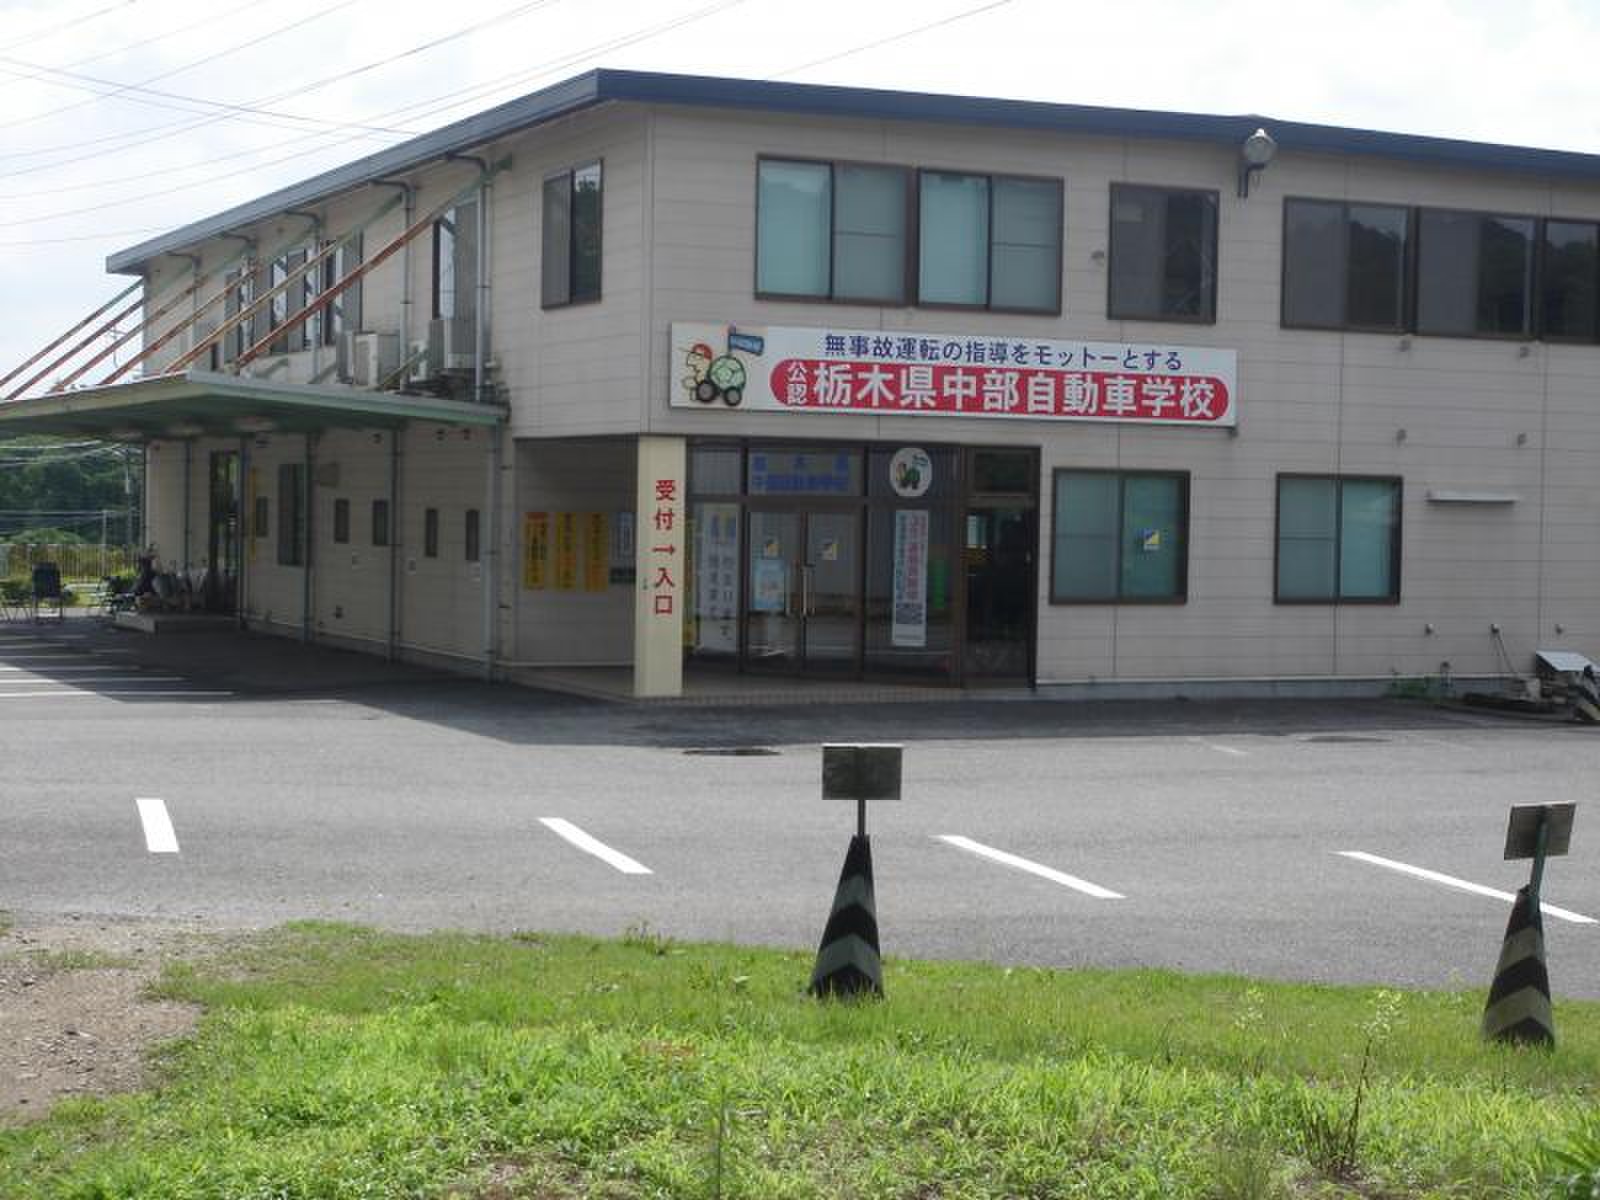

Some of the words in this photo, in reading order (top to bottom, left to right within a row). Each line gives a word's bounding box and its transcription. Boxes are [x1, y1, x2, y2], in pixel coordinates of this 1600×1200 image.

[824, 334, 1182, 371] 無事故運転の指導をモットーとする
[787, 361, 807, 404] 公認
[814, 361, 1215, 418] 栃木県中部自動車学校
[655, 479, 676, 530] 受付
[655, 567, 676, 614] 入口
